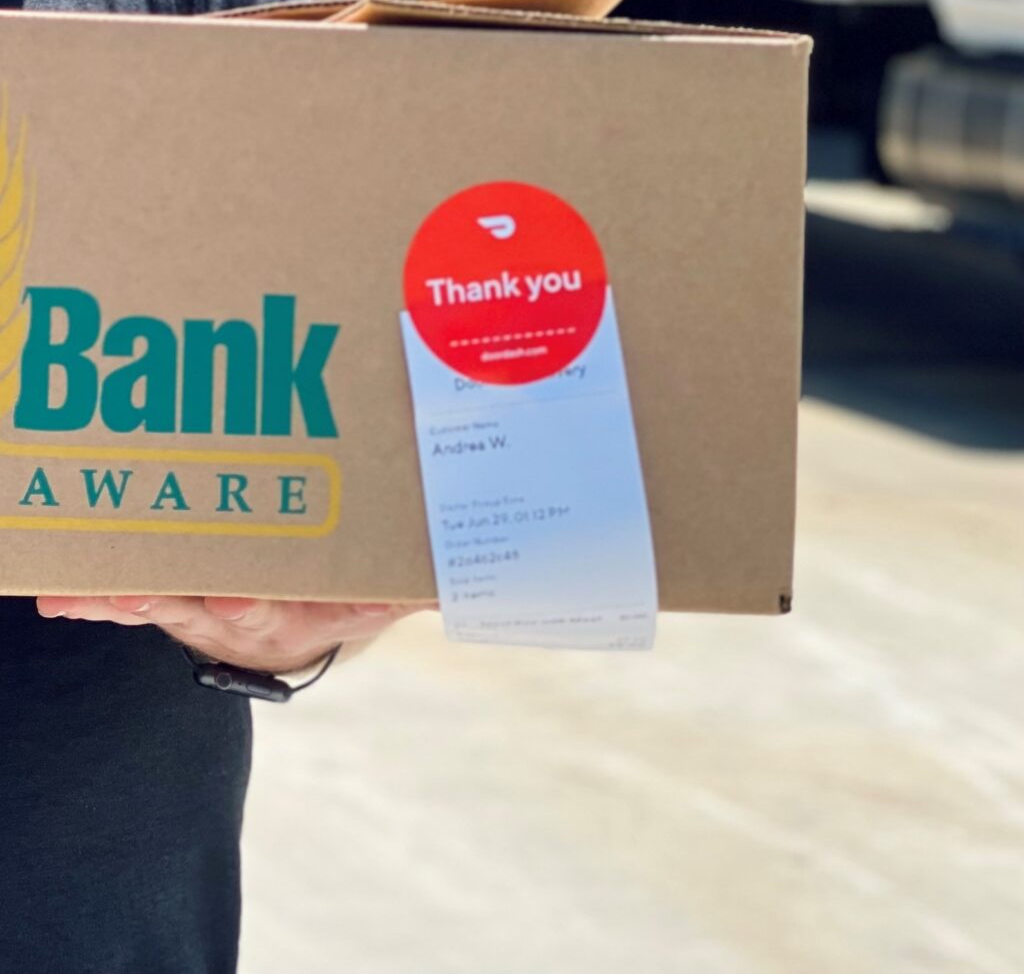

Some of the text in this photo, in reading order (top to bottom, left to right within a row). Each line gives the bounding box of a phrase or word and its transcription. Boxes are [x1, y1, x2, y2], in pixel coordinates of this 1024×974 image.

[425, 270, 582, 306] Thank you
[13, 286, 342, 439] Bank
[432, 440, 485, 457] Andrea
